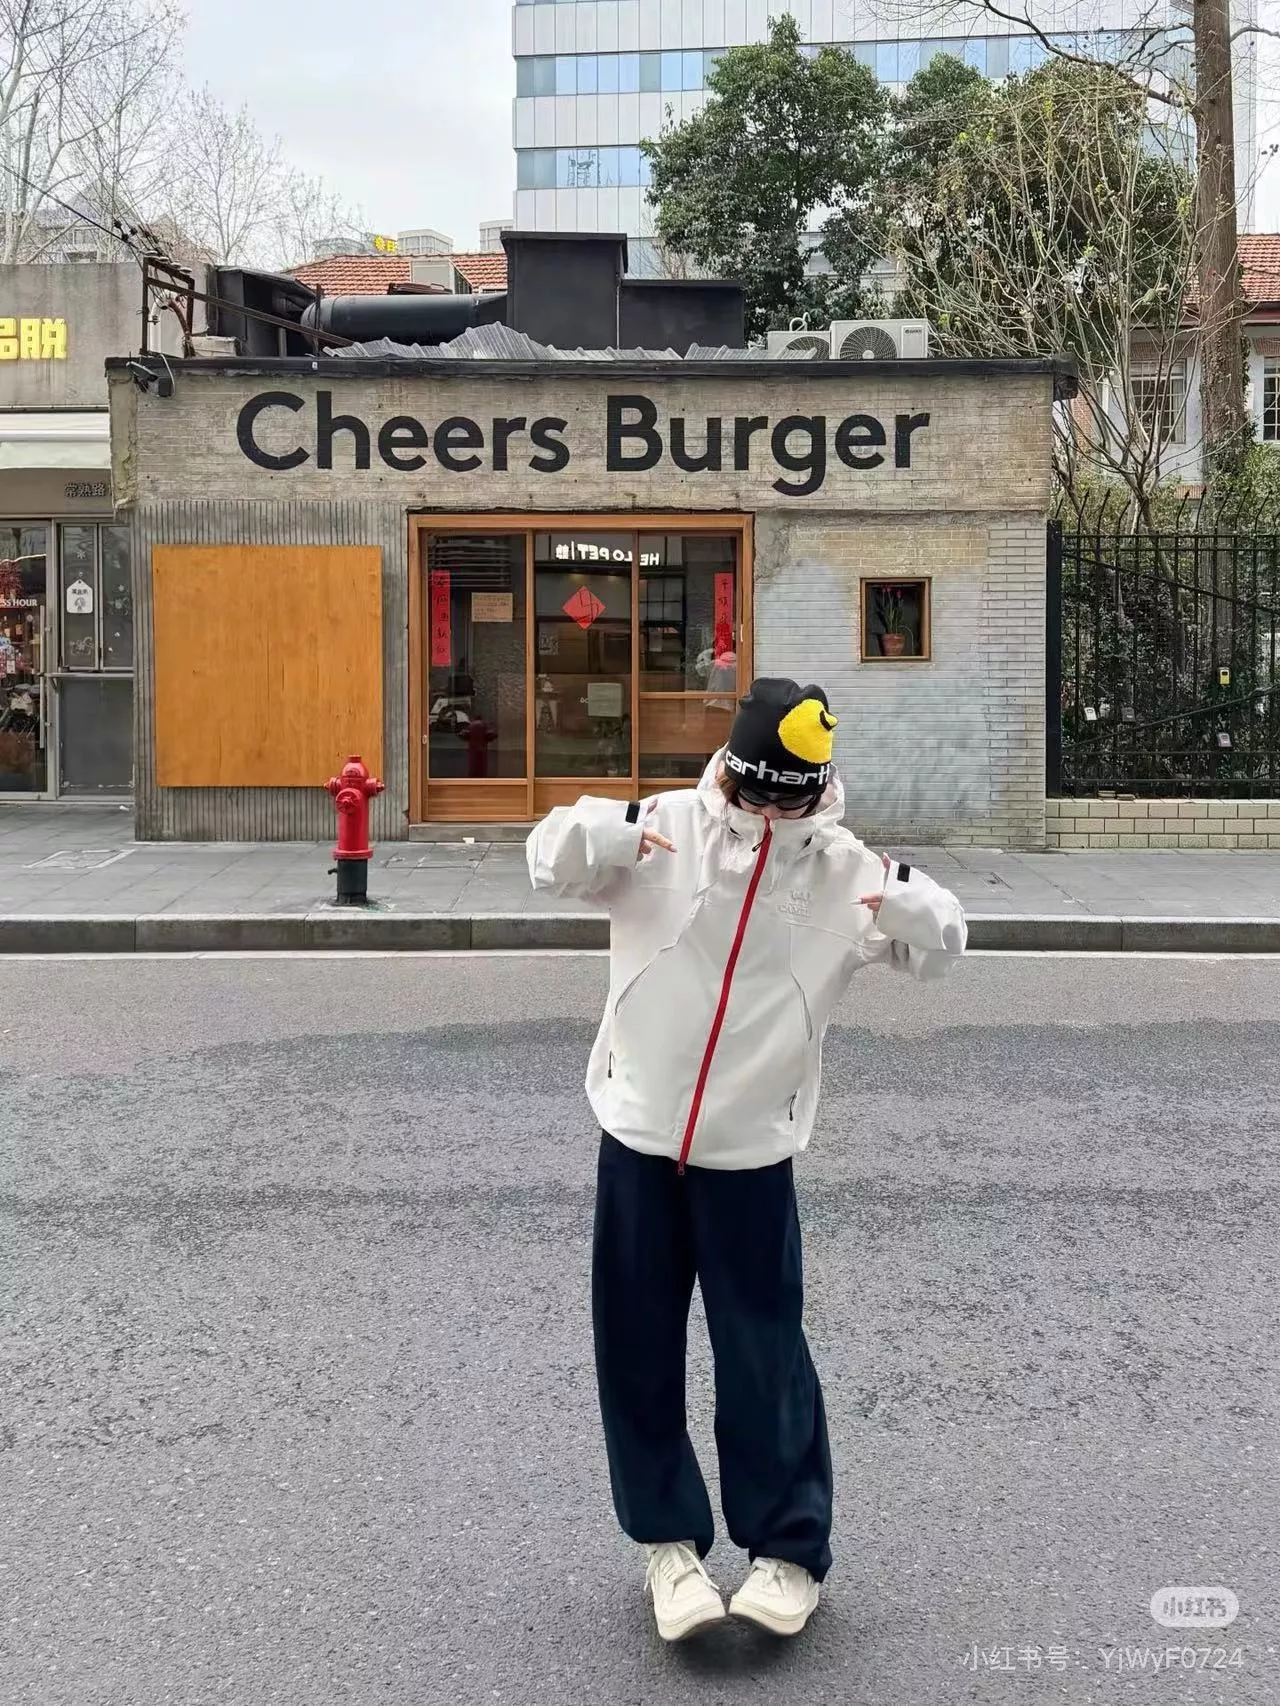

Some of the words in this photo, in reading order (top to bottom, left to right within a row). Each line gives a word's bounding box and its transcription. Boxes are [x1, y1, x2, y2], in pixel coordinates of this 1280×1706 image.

[236, 390, 571, 473] Cheers
[606, 393, 931, 497] Burger
[13, 598, 38, 607] HOUR
